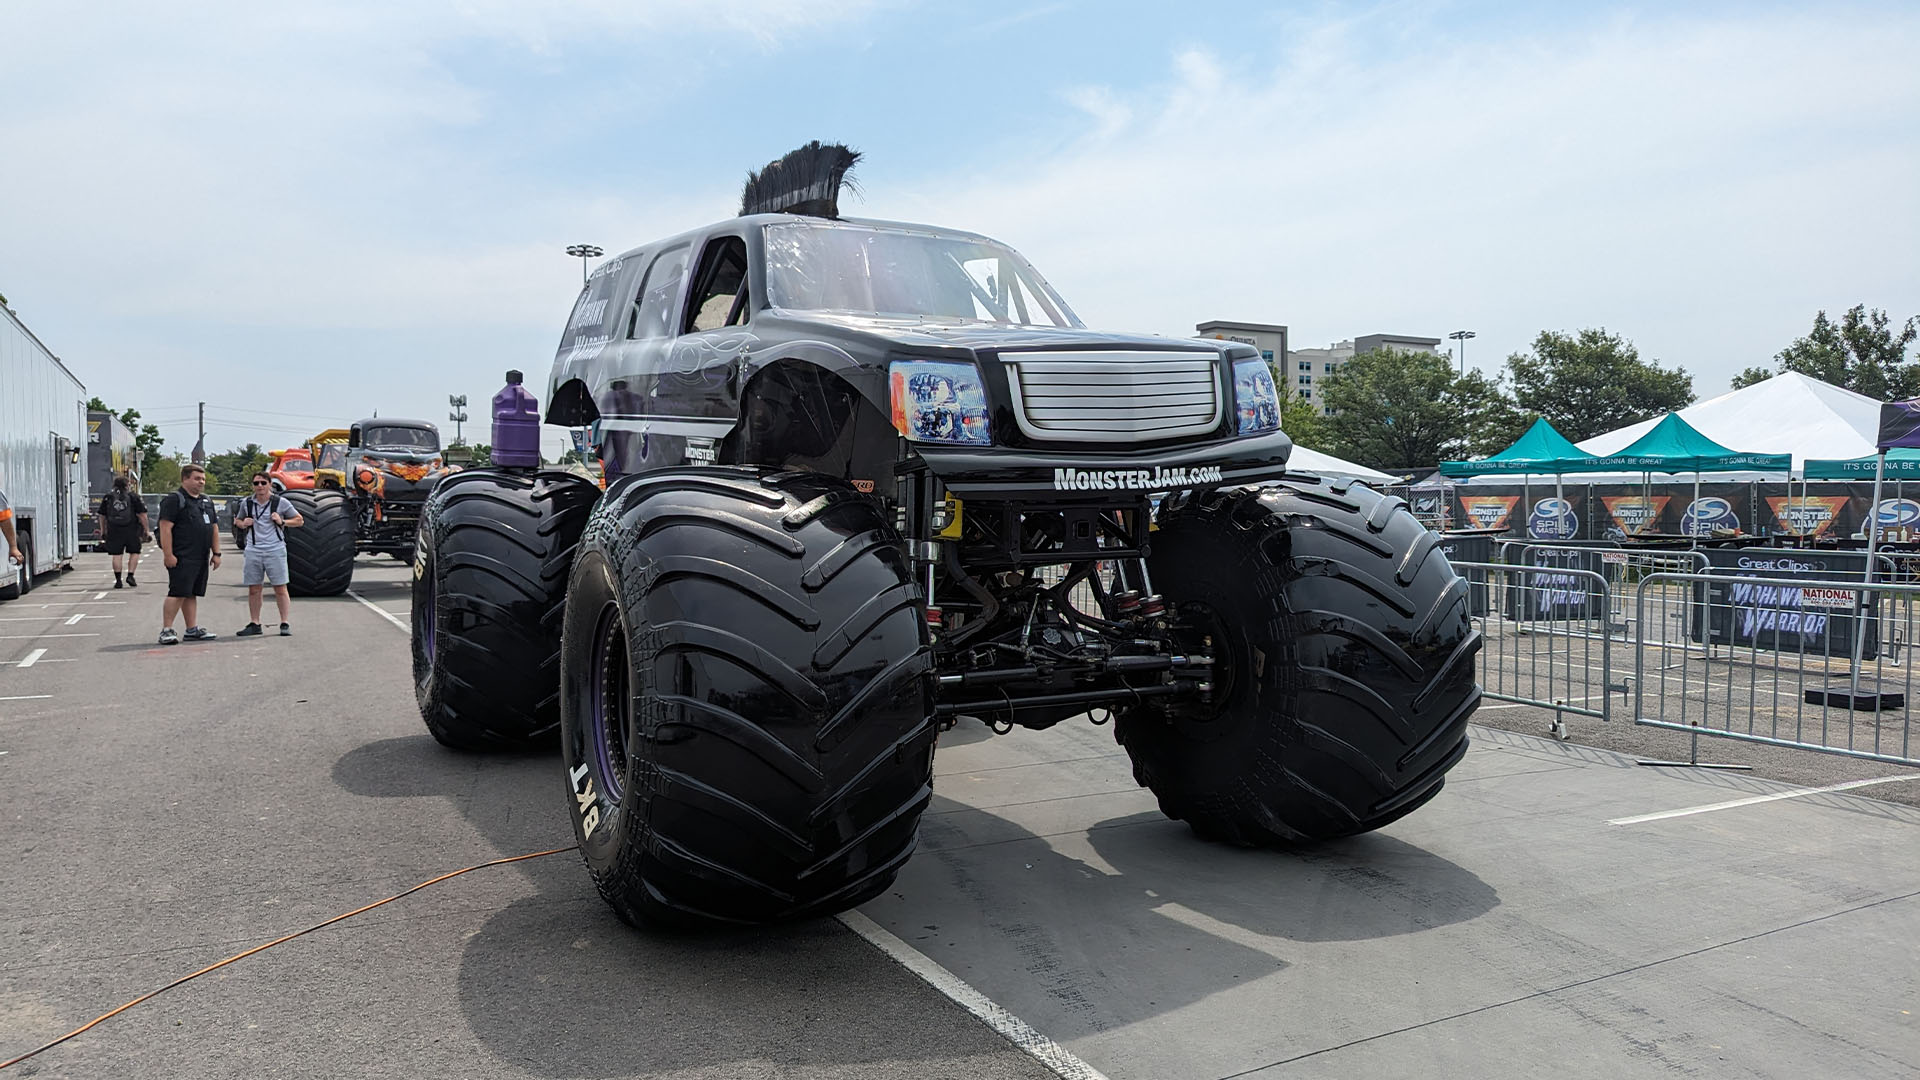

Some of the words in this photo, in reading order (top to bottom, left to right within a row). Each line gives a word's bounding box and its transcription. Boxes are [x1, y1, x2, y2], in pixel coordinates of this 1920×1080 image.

[685, 447, 715, 461] MONSTER
[1585, 457, 1598, 465] IT'S
[1600, 457, 1626, 465] GONNA
[1627, 457, 1637, 465] BE
[1639, 457, 1664, 465] GREAT
[1729, 457, 1747, 465] GONNA
[1863, 462, 1899, 470] GONA
[1902, 462, 1915, 470] BE
[1468, 508, 1508, 516] MONSTER
[1737, 557, 1777, 571] Great
[1777, 558, 1810, 575] Clips
[1802, 588, 1854, 600] NATIONAL
[569, 762, 600, 841] BKT
